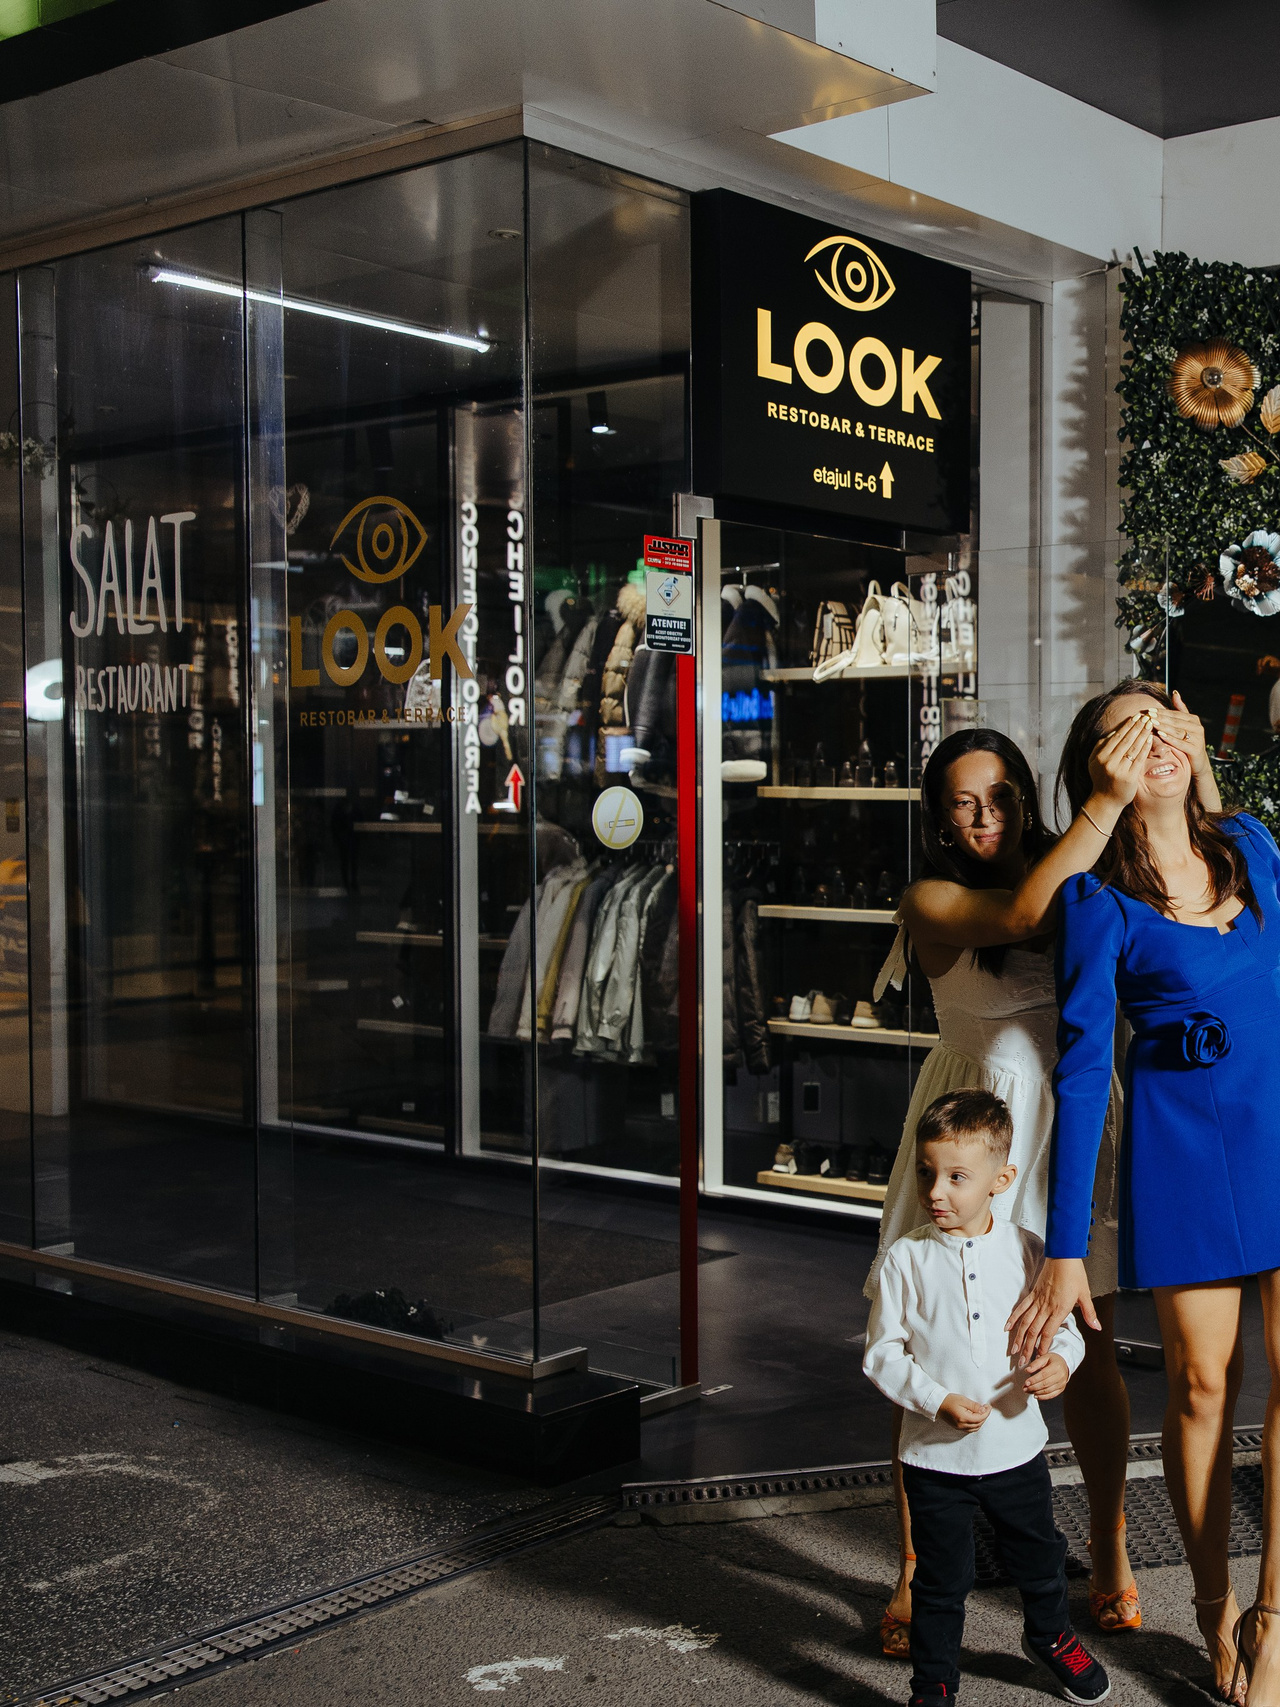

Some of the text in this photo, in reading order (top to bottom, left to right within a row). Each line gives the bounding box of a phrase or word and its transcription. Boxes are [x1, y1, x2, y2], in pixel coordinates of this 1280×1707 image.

[757, 308, 943, 421] LOOK
[767, 402, 935, 453] RESTOBAR & TERRACE
[813, 466, 877, 494] etajul 5-6
[69, 511, 197, 639] SALAT
[291, 603, 475, 688] LOOK
[76, 662, 192, 715] RESTAURANT
[299, 705, 467, 727] RESTOBAR & TERRACE
